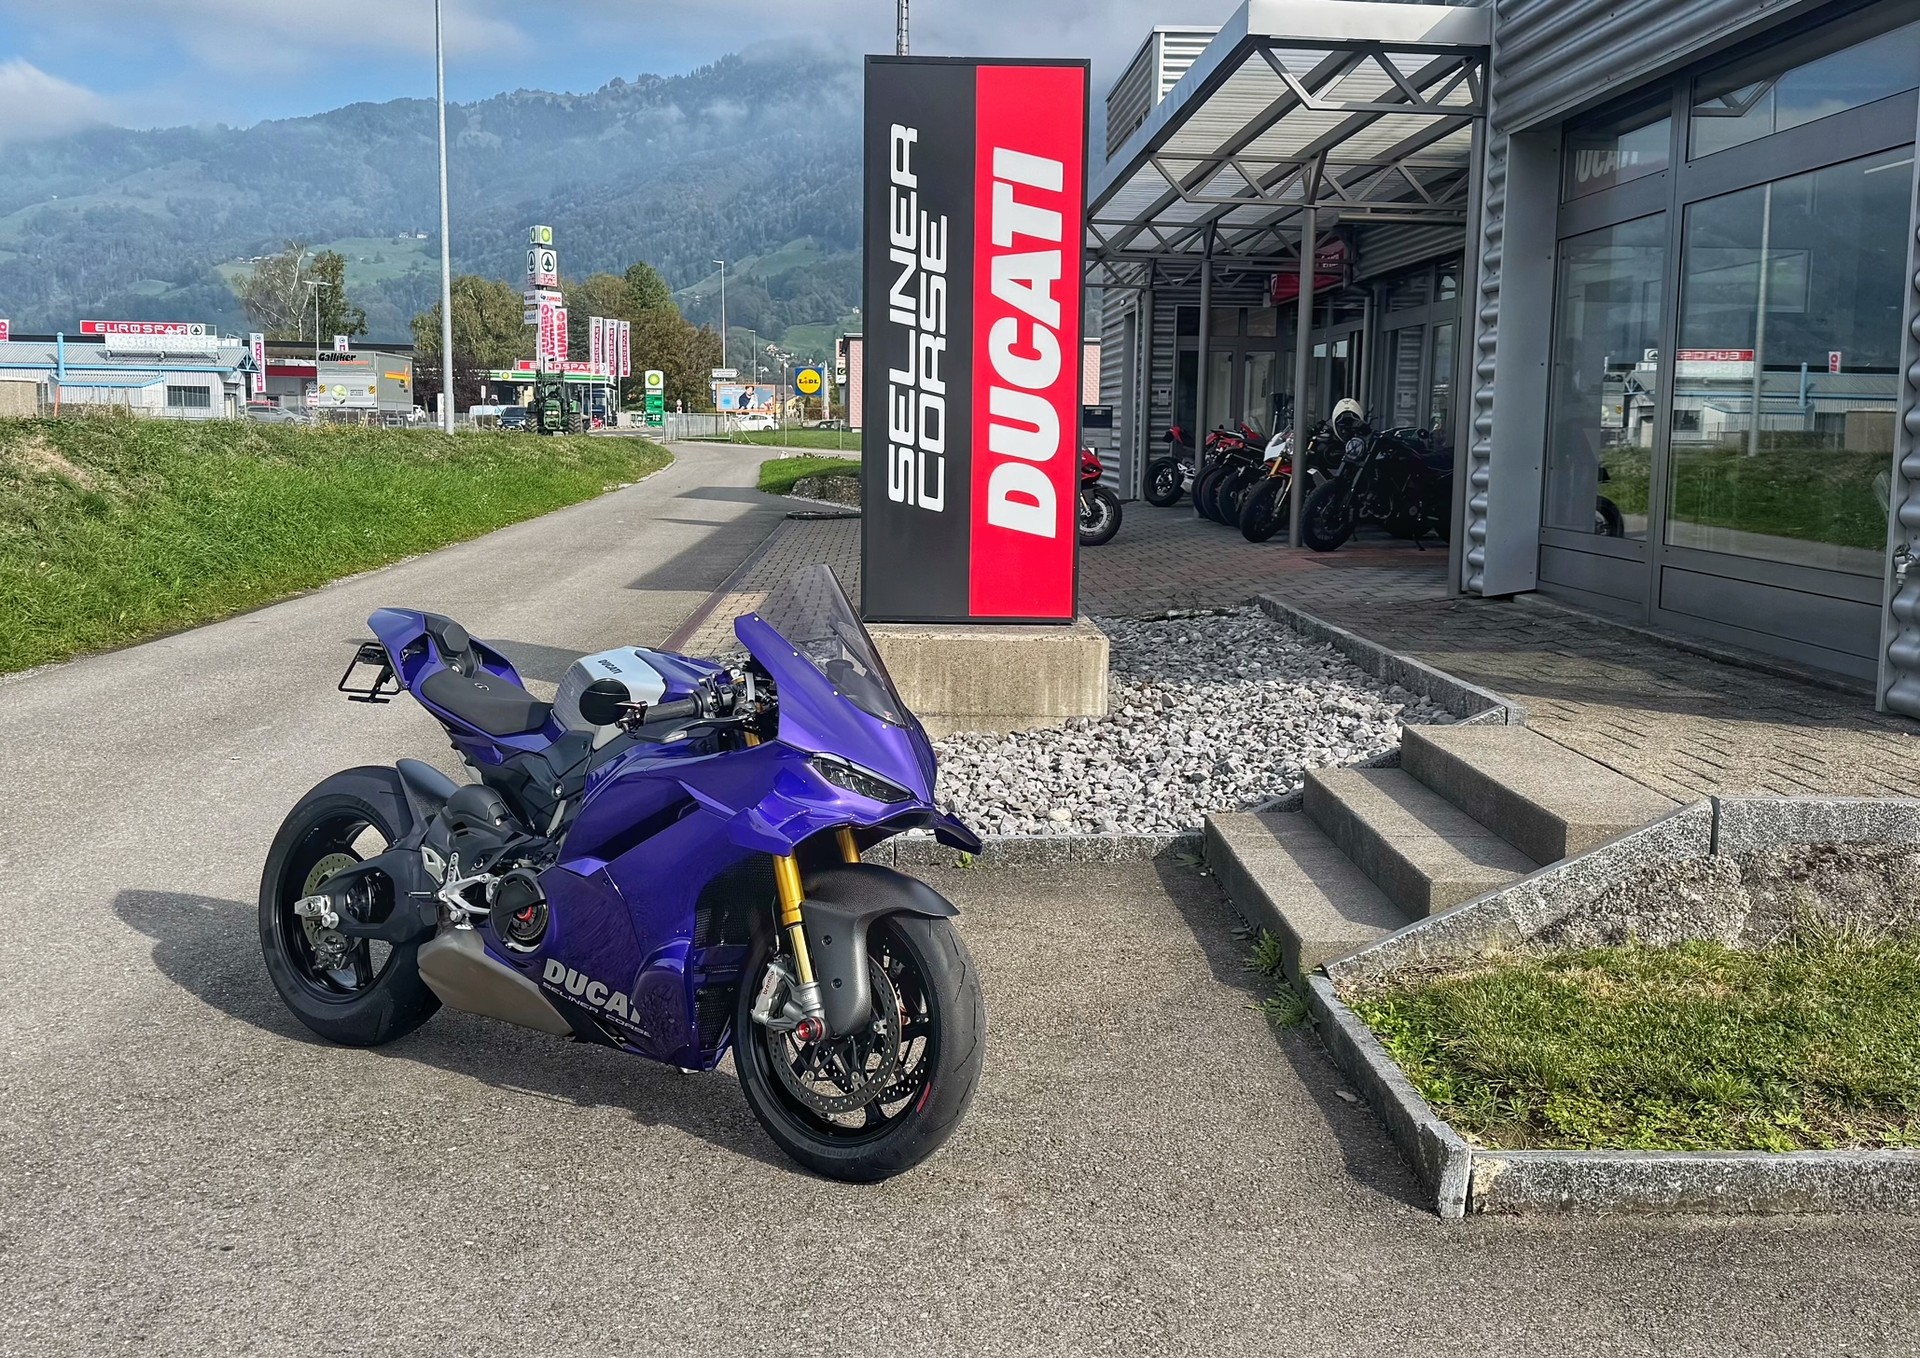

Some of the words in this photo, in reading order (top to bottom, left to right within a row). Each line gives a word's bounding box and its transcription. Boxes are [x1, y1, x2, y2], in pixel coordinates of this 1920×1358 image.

[95, 323, 187, 334] EUROSPAR
[541, 304, 549, 353] JUMBO
[556, 310, 567, 359] JUMBO
[888, 123, 918, 505] SELINER
[318, 352, 357, 362] Galliker
[918, 209, 948, 513] CORSE
[987, 147, 1064, 538] DUCATI
[762, 970, 775, 995] brembo
[542, 982, 599, 1014] SELINER
[605, 1013, 652, 1038] CORSE
